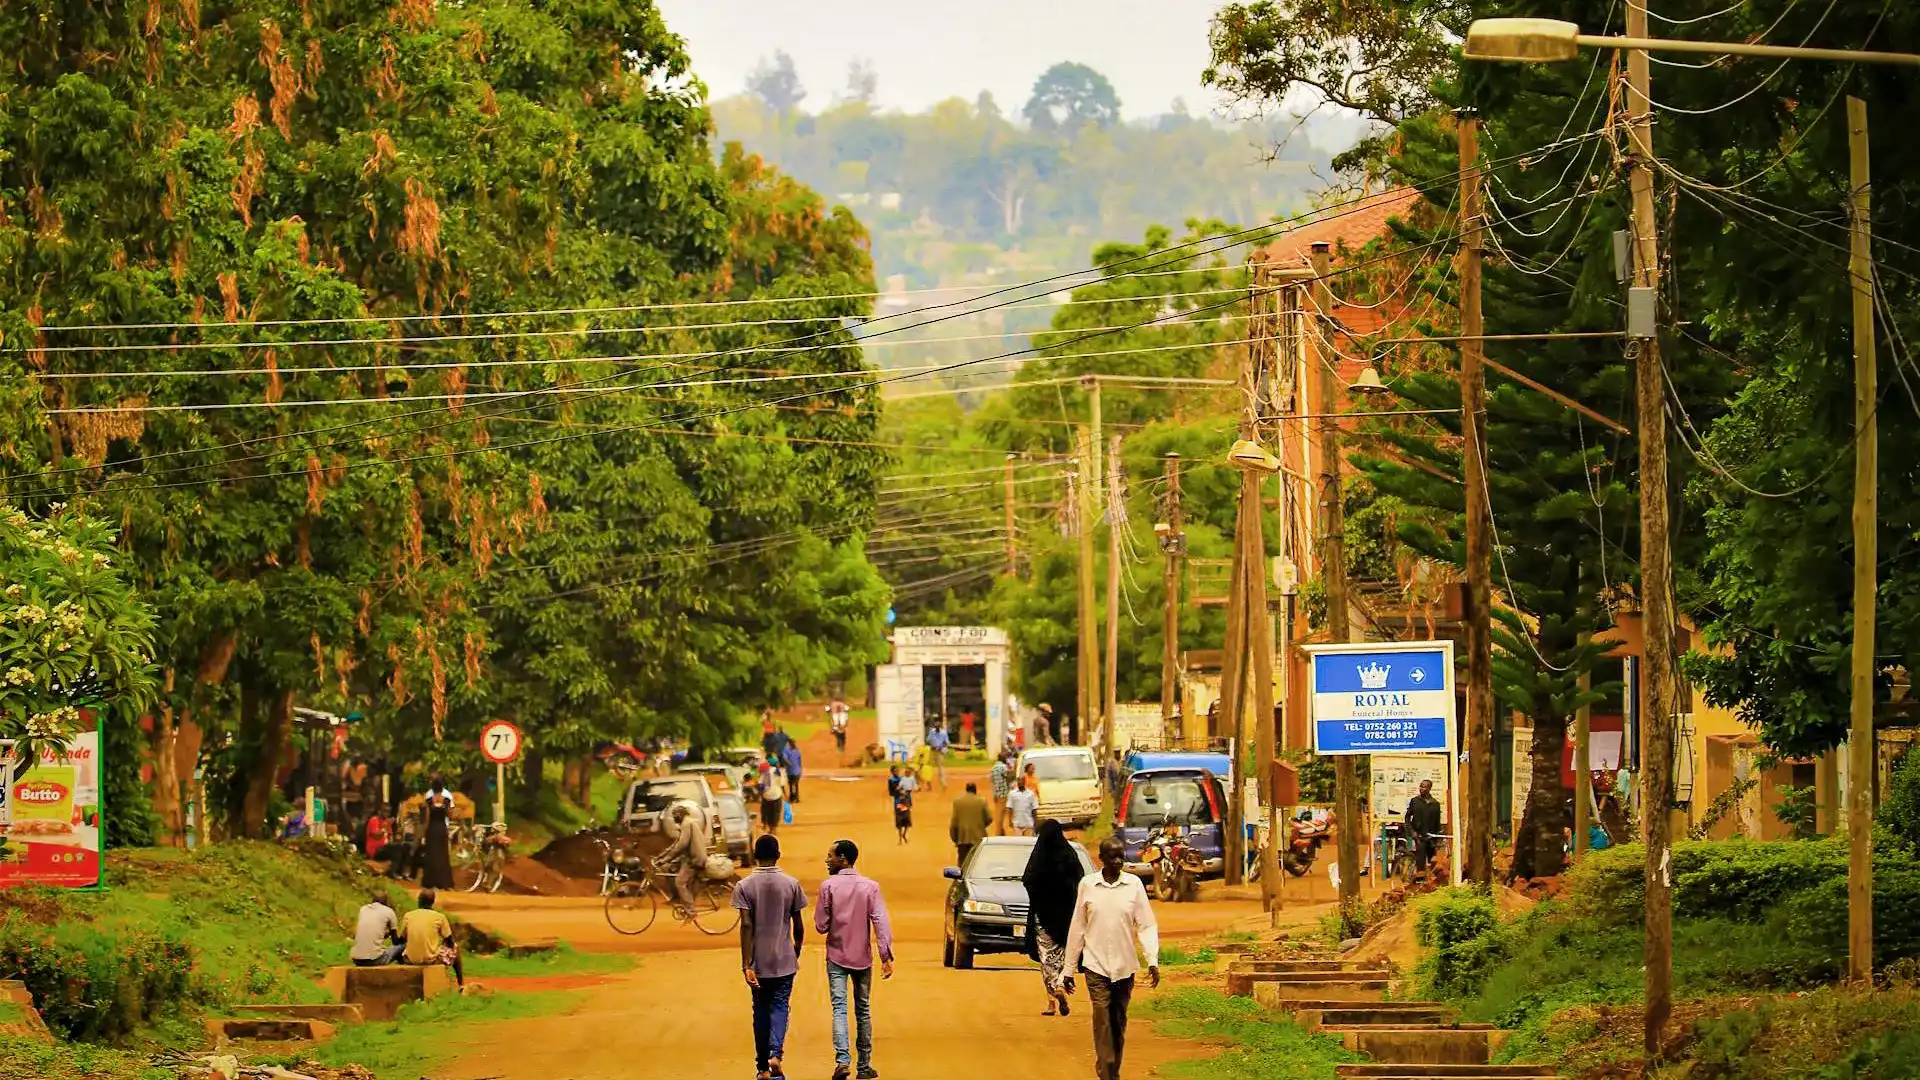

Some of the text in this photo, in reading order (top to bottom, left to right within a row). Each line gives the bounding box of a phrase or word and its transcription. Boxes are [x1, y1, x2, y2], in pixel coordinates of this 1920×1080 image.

[1355, 694, 1410, 706] ROYAL
[1344, 721, 1418, 731] TEL: 0752 260 321
[1365, 731, 1385, 739] 0782
[1403, 730, 1418, 738] 957
[41, 747, 91, 762] Ugnda
[20, 788, 60, 801] Butto
